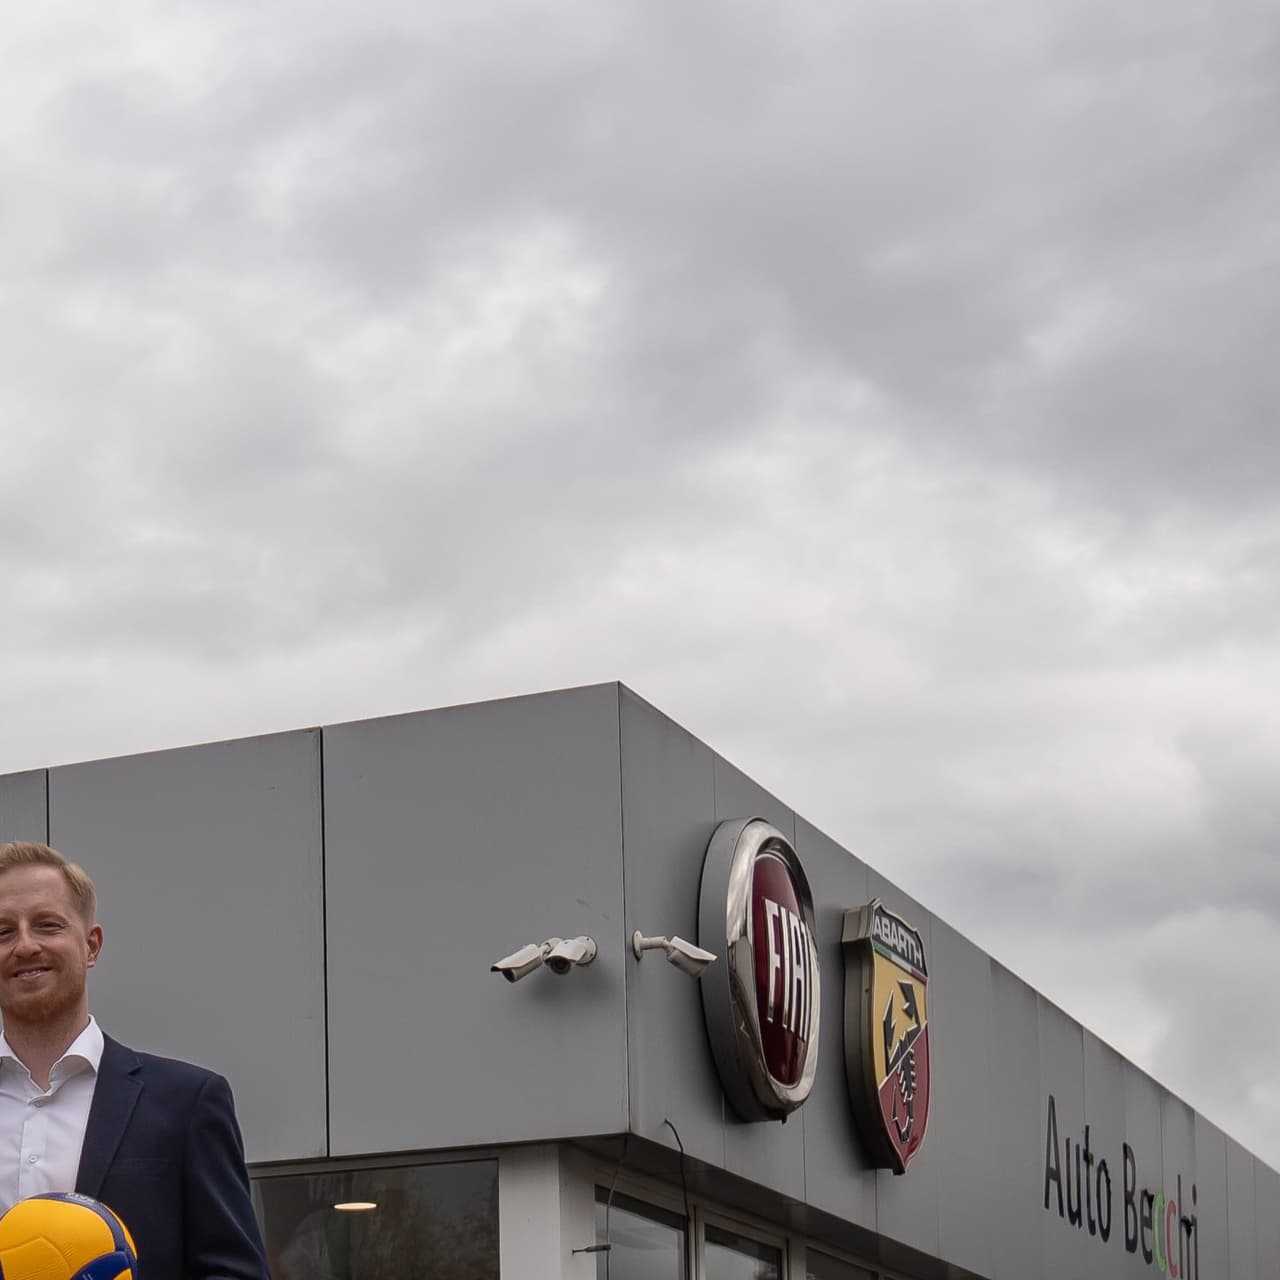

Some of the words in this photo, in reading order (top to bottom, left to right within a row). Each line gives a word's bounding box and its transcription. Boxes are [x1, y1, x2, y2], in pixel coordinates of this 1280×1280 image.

[765, 898, 812, 1042] FIAT
[873, 914, 923, 968] ABARTH
[1044, 1095, 1112, 1243] Auto
